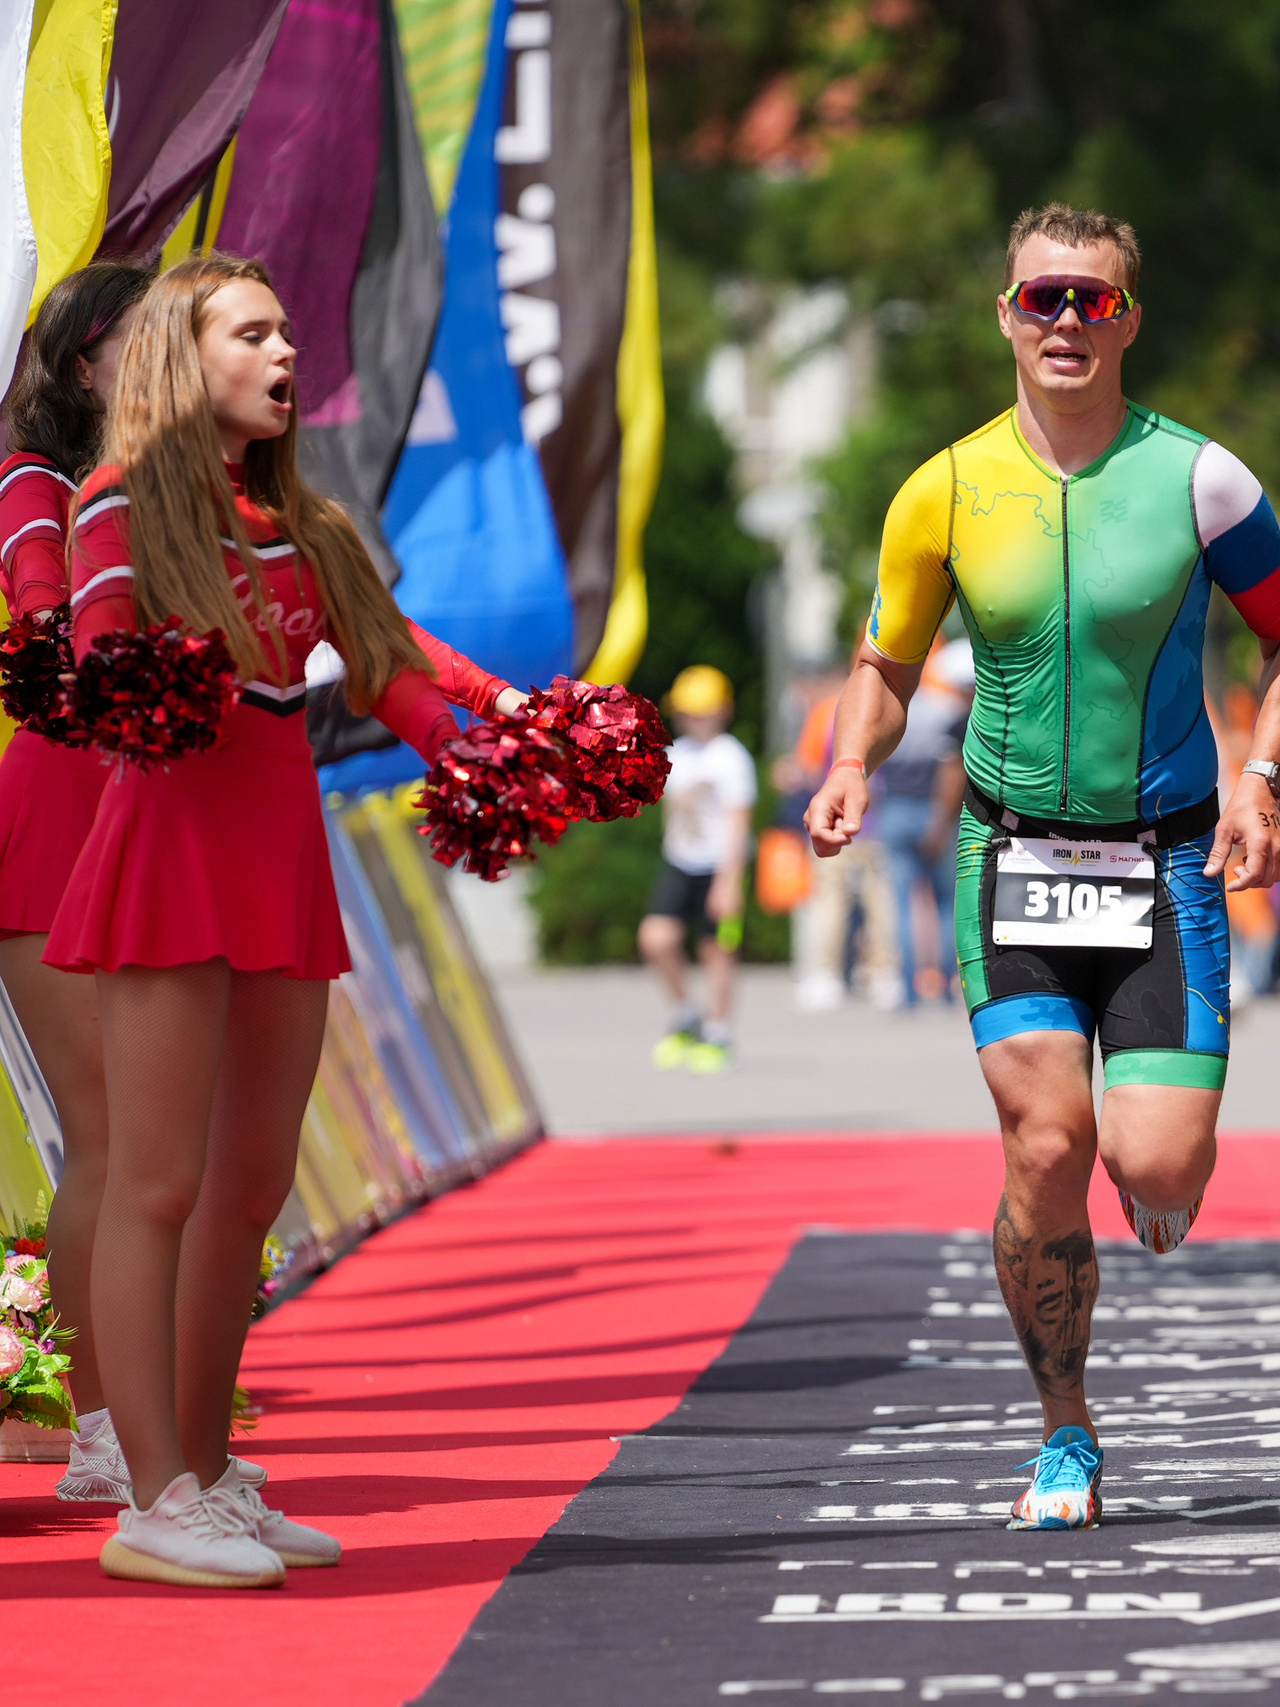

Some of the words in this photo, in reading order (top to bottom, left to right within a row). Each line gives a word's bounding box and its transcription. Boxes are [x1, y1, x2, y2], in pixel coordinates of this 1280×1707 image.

[1052, 848, 1072, 859] IRON
[1080, 849, 1101, 860] STAR
[1024, 880, 1123, 921] 3105
[772, 1592, 1201, 1613] IRON
